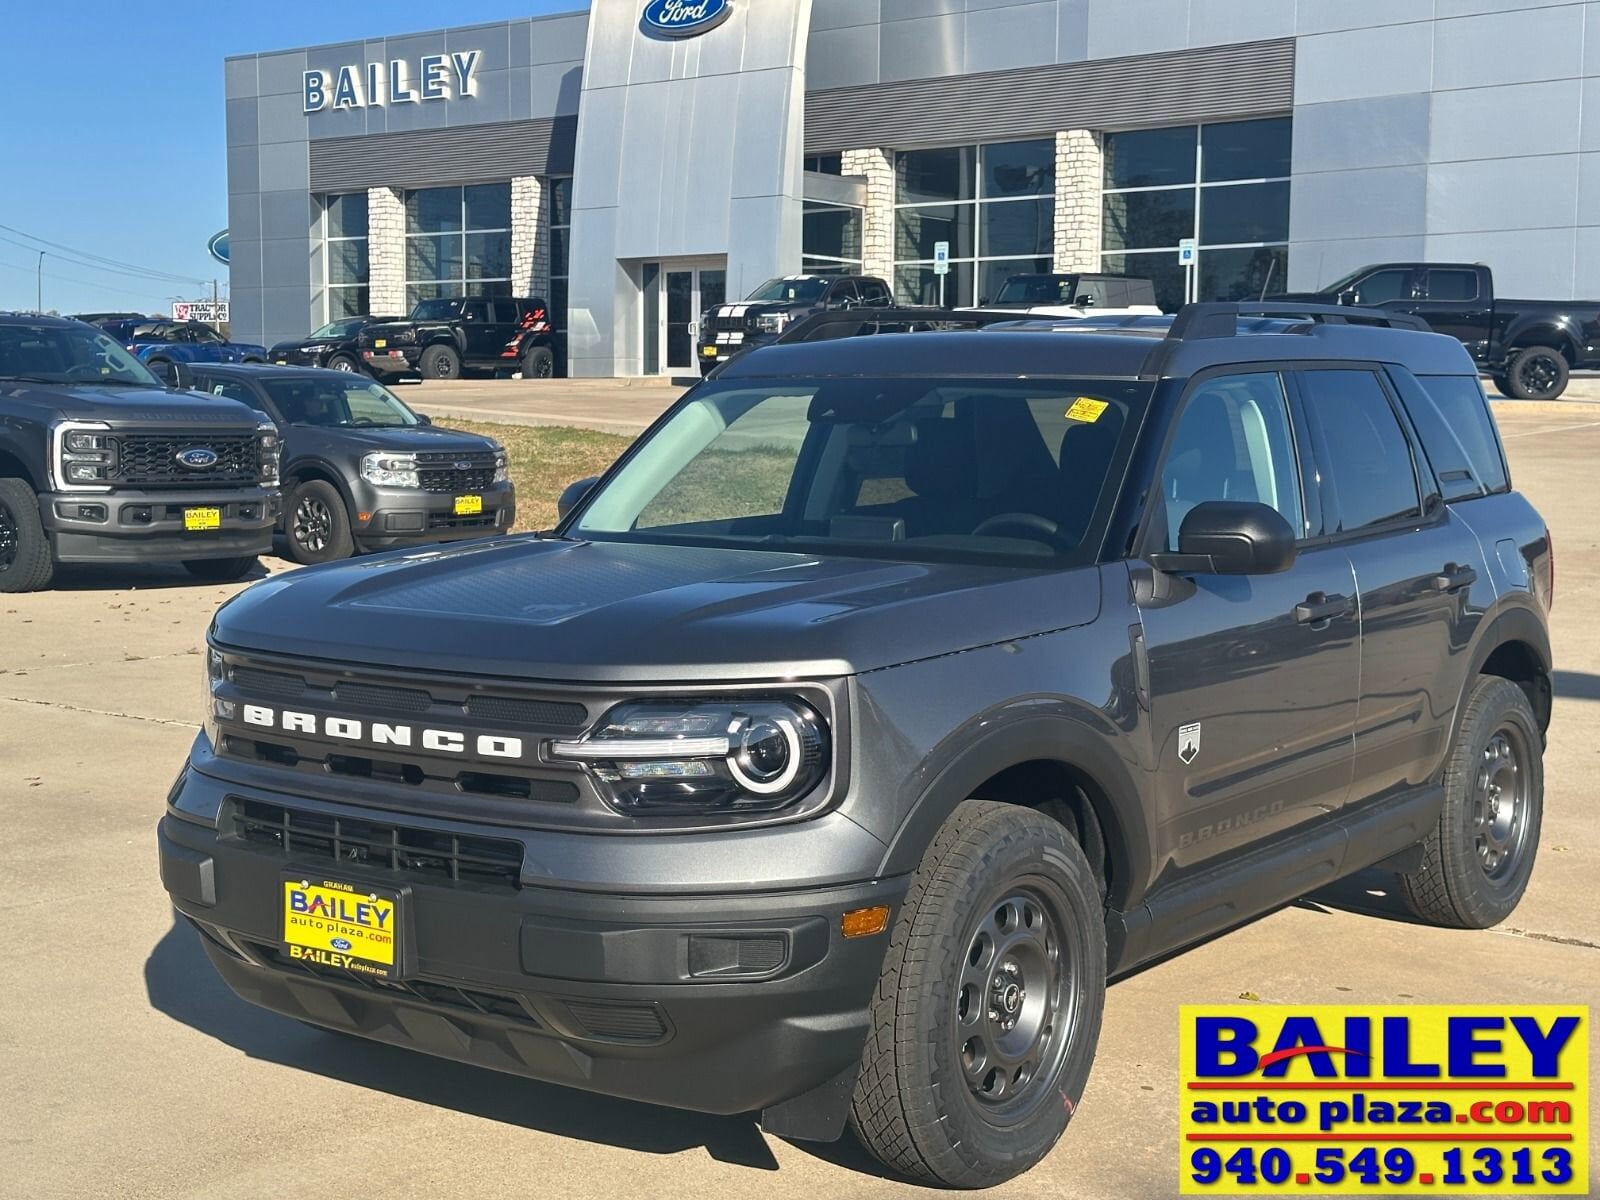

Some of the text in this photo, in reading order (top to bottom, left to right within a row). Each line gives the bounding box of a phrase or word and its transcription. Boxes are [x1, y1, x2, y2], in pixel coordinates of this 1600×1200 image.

[659, 0, 707, 24] Ford
[303, 50, 481, 113] BAILEY
[186, 511, 217, 519] BAILEY
[243, 704, 523, 758] BRONCO
[1179, 799, 1285, 850] BRONCO
[323, 880, 354, 892] GRAHAM
[290, 890, 391, 929] BAILEY
[290, 916, 324, 929] auto
